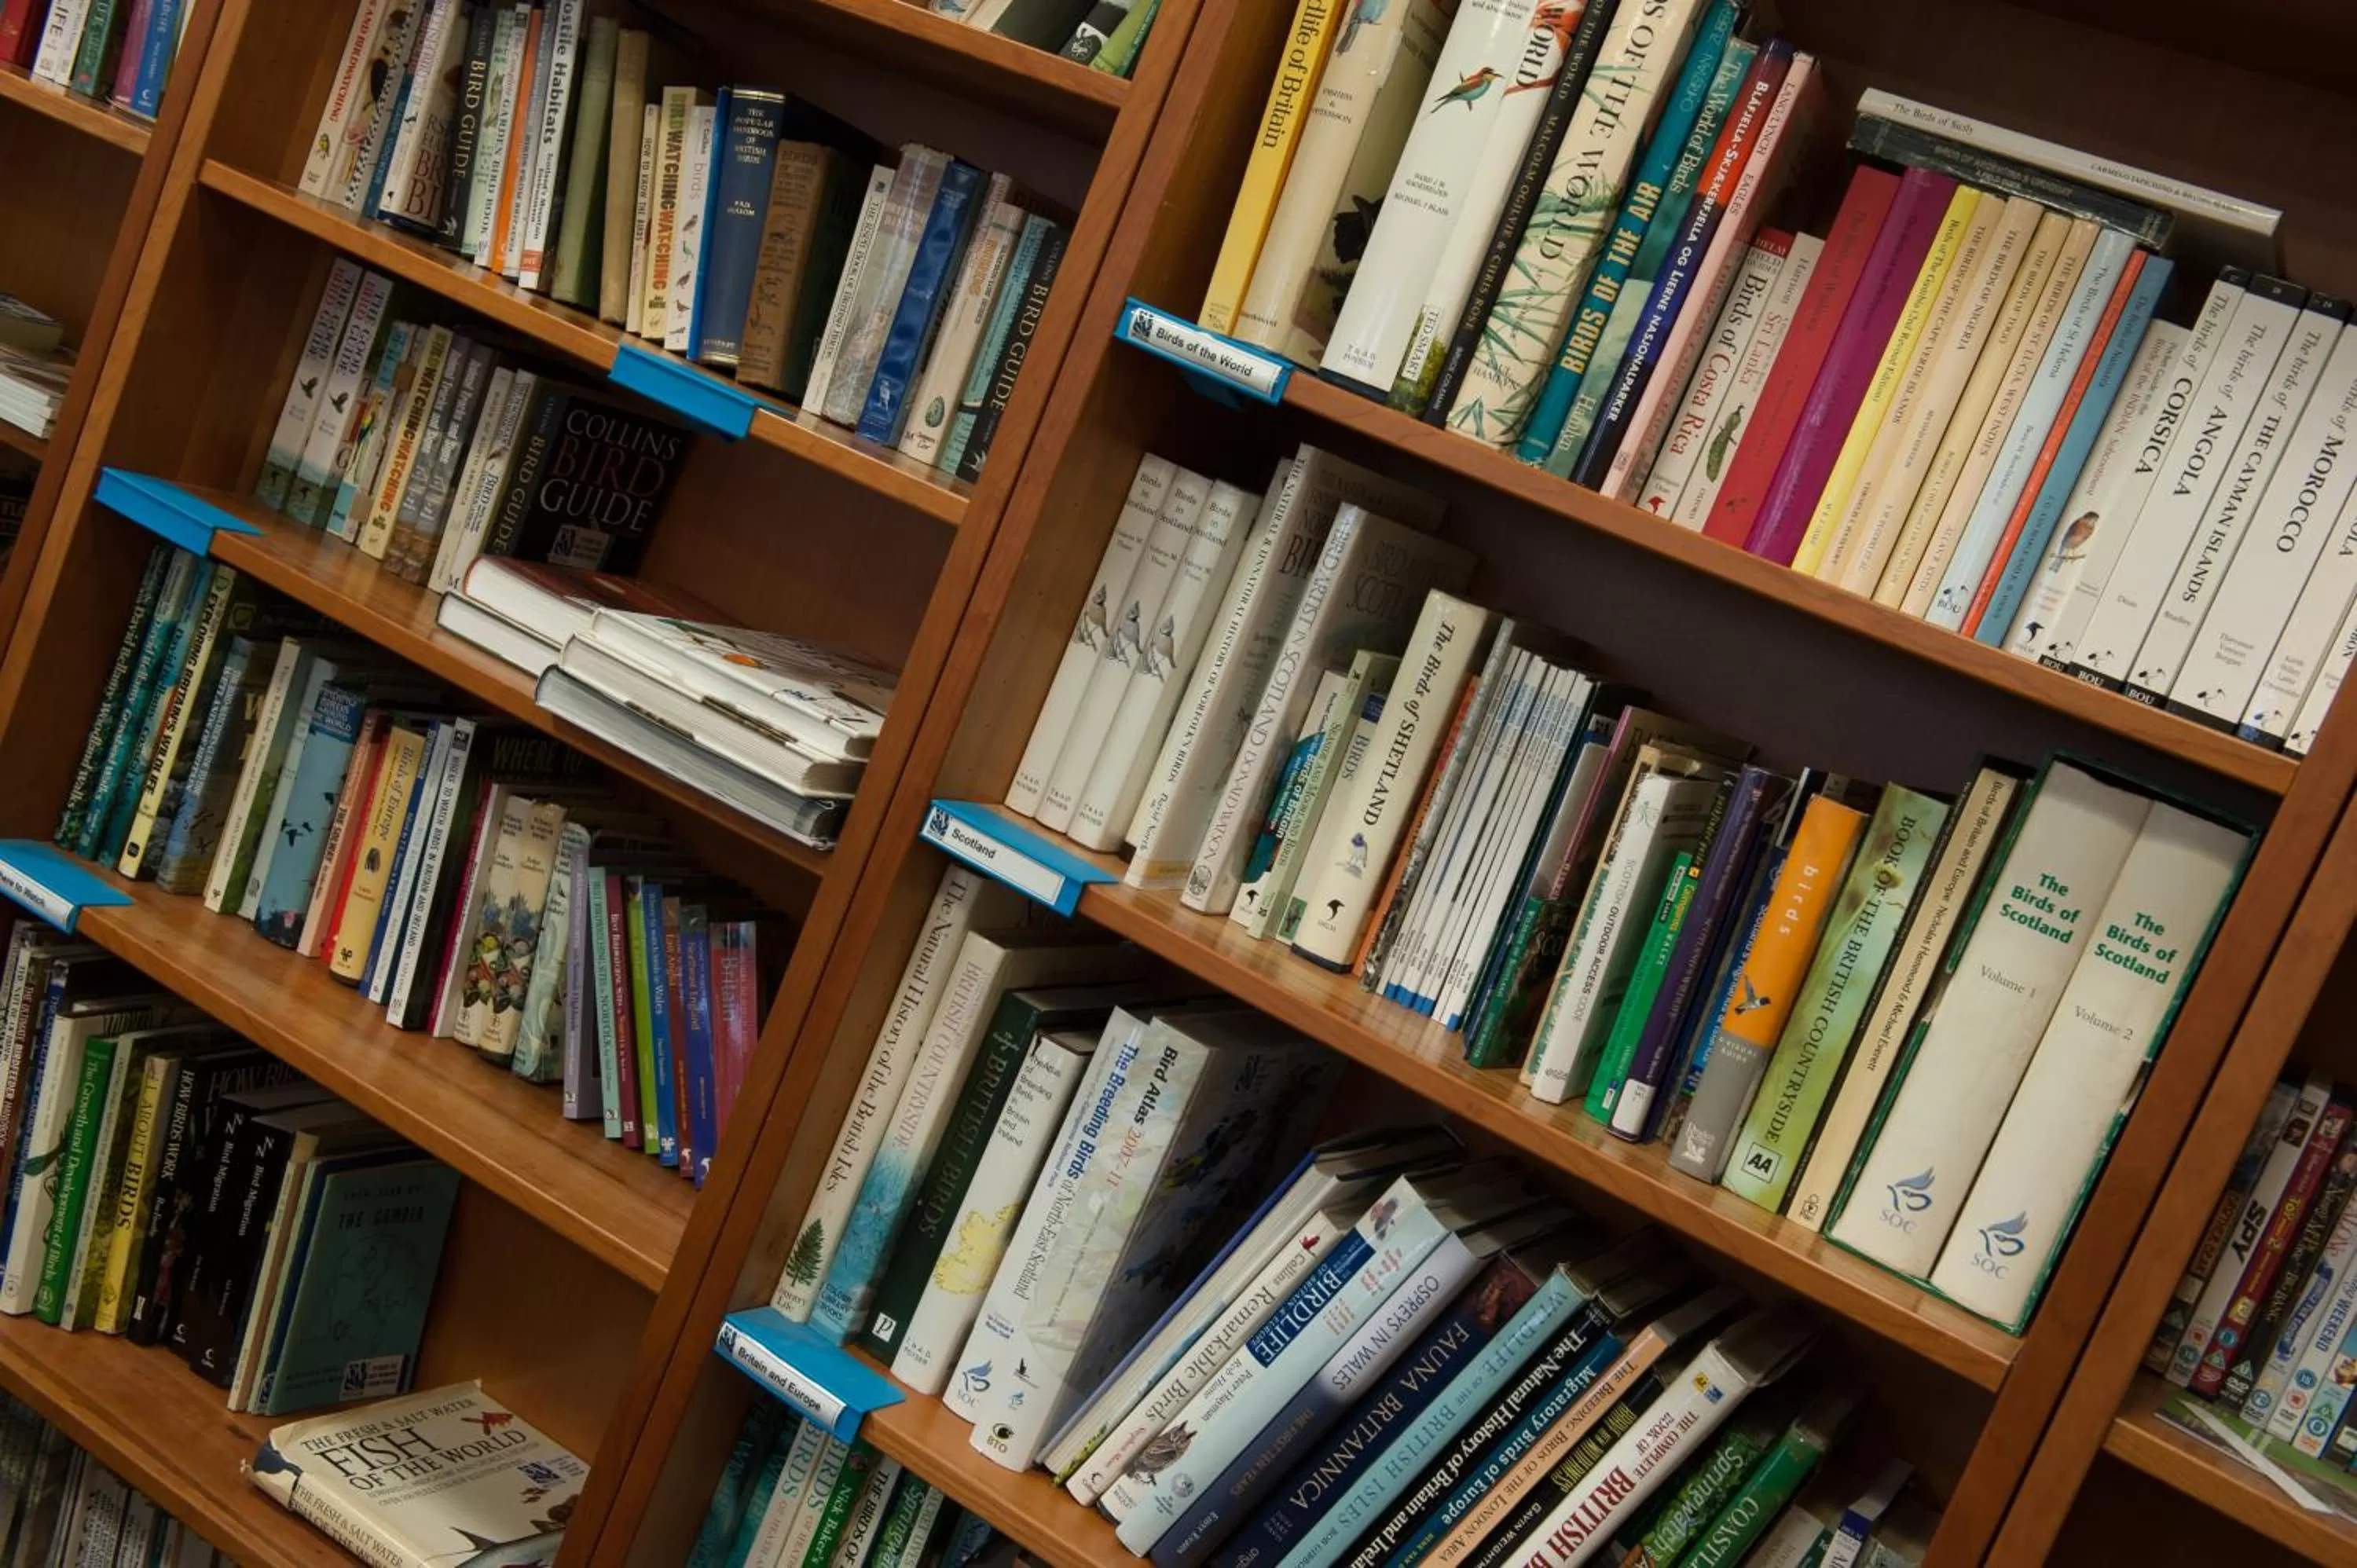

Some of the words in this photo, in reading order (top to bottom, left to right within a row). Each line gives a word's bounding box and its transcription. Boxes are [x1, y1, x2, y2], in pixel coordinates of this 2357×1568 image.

[557, 1, 575, 55] ostile
[1620, 22, 1656, 66] OF
[464, 60, 485, 108] BIRD
[543, 63, 566, 143] Habitats
[1588, 71, 1635, 141] THE
[452, 115, 475, 177] GUIDE
[687, 161, 706, 202] birds
[1535, 145, 1606, 262] WORLD
[1626, 180, 1662, 221] AIR
[1605, 227, 1640, 269] THE
[1017, 283, 1047, 335] BIRD
[1592, 274, 1622, 303] OF
[1728, 272, 1765, 328] Birds
[2206, 294, 2229, 321] The
[1560, 309, 1606, 372] BIRDS
[1716, 327, 1743, 354] of
[1761, 310, 1783, 336] Sri
[2190, 321, 2216, 353] birds
[2244, 321, 2267, 350] The
[2298, 328, 2322, 357] The
[1156, 327, 1185, 350] Birds
[1186, 339, 1199, 354] of
[1200, 346, 1218, 363] the
[1219, 354, 1253, 379] World
[1739, 338, 1770, 387] Lanka
[2180, 350, 2201, 372] of
[2228, 349, 2253, 380] birds
[2283, 357, 2308, 388] birds
[990, 342, 1027, 409] GUIDE
[1692, 351, 1731, 408] Costa
[2217, 378, 2239, 400] of
[2271, 387, 2293, 408] of
[569, 409, 679, 459] COLLINS
[1558, 394, 1595, 453] Hamlyn
[1670, 412, 1704, 457] Rica
[2132, 376, 2194, 477] CORSICA
[2253, 412, 2282, 450] THE
[519, 436, 545, 493] BIRD
[555, 435, 663, 496] BIRD
[2171, 405, 2230, 500] ANGOLA
[543, 478, 649, 533] GUIDE
[2216, 451, 2264, 527] CAYMAN
[494, 497, 529, 554] GUIDE
[2179, 529, 2227, 603] ISLANDS
[123, 606, 144, 645] David
[1431, 621, 1455, 653] The
[104, 647, 130, 698] Bellamy
[1413, 653, 1442, 698] Birds
[2077, 670, 2104, 687] BOU
[1398, 698, 1424, 721] of
[2128, 688, 2155, 707] BOU
[80, 702, 112, 767] Woodland
[394, 745, 415, 778] Birds
[1296, 753, 1317, 786] Birds
[1340, 734, 1369, 781] BIRDS
[1361, 721, 1415, 826] SHETLAND
[66, 768, 89, 809] Walks
[389, 778, 406, 793] of
[1290, 785, 1304, 799] of
[376, 795, 401, 841] Europe
[1275, 799, 1298, 839] Britain
[951, 827, 997, 860] Scotland
[1882, 813, 1915, 868] BOOK
[943, 881, 969, 916] The
[1870, 869, 1893, 896] OF
[2039, 873, 2069, 896] The
[1853, 897, 1881, 936] THE
[2002, 903, 2072, 944] Scotland
[2012, 886, 2055, 914] Birds
[2060, 907, 2082, 925] of
[2134, 913, 2165, 936] The
[912, 918, 950, 983] Natural
[2096, 945, 2169, 985] Scotland
[2108, 925, 2150, 954] Birds
[2155, 947, 2179, 965] of
[720, 956, 738, 1021] Britain
[940, 960, 980, 1034] BRITISH
[1820, 938, 1861, 1013] BRITISH
[654, 984, 663, 1014] Wales
[884, 983, 923, 1050] History
[2076, 1006, 2121, 1037] Volume
[2124, 1027, 2135, 1042] 2
[874, 1050, 896, 1074] of
[1113, 1042, 1138, 1072] The
[1153, 1045, 1178, 1081] Bird
[1765, 1015, 1827, 1143] COUNTRYSIDE
[176, 1070, 195, 1098] HOW
[863, 1071, 887, 1100] the
[892, 1034, 950, 1152] COUNTRYSIDE
[1083, 1071, 1124, 1138] Breeding
[1133, 1082, 1163, 1127] Atlas
[167, 1101, 189, 1140] BIRDS
[841, 1101, 877, 1157] British
[159, 1141, 181, 1180] WORK
[220, 1141, 235, 1163] Bird
[1065, 1139, 1095, 1181] Birds
[1106, 1127, 1143, 1188] 2007-11
[111, 1162, 145, 1229] BIRDS
[206, 1164, 228, 1212] Migration
[250, 1164, 265, 1186] Bird
[826, 1157, 853, 1195] Isles
[1058, 1178, 1079, 1196] of
[236, 1189, 258, 1236] Migration
[1034, 1192, 1072, 1252] North-East
[2228, 1201, 2267, 1263] SPY
[1012, 1249, 1047, 1300] Scotland
[1271, 1251, 1306, 1288] Collins
[1972, 1252, 2009, 1280] SOC
[1254, 1266, 1340, 1364] BIRDLIFE
[1384, 1272, 1441, 1333] OSPREYS
[2315, 1296, 2352, 1353] WEEKEND
[1185, 1283, 1274, 1384] Remarkable
[1369, 1326, 1391, 1349] IN
[737, 1346, 768, 1376] Britain
[768, 1367, 787, 1389] and
[788, 1381, 822, 1413] Europe
[1331, 1342, 1375, 1391] WALES
[1401, 1319, 1468, 1396] FAUNA
[1611, 1357, 1637, 1385] THE
[1145, 1376, 1189, 1427] Birds
[1531, 1361, 1594, 1432] Migratory
[1564, 1379, 1615, 1435] BREEDING
[301, 1434, 332, 1452] THE
[337, 1424, 377, 1444] FRESH
[382, 1419, 393, 1432] &
[395, 1409, 427, 1427] SALT
[431, 1399, 475, 1418] WATER
[1674, 1409, 1699, 1434] THE
[320, 1427, 443, 1477] FISH
[350, 1470, 383, 1490] OF
[385, 1455, 441, 1480] THE
[446, 1430, 525, 1462] WORLD
[987, 1436, 1007, 1455] BTO
[1291, 1388, 1400, 1515] BRITANNICA
[1497, 1427, 1534, 1467] Birds
[1534, 1428, 1569, 1464] BIRDS
[1633, 1429, 1678, 1480] COMPLETE
[868, 1471, 888, 1499] THE
[1482, 1462, 1502, 1482] of
[1503, 1474, 1524, 1497] THE
[1521, 1458, 1540, 1478] OF
[830, 1483, 852, 1515] Nick
[851, 1498, 878, 1541] BIRDS
[1439, 1476, 1486, 1527] Europe
[1463, 1492, 1506, 1541] LONDON
[1546, 1465, 1634, 1562] BRITISH
[1647, 1444, 1744, 1552] Springwatch
[811, 1518, 838, 1565] Baker's
[841, 1541, 860, 1565] OF
[1438, 1534, 1466, 1564] AREA
